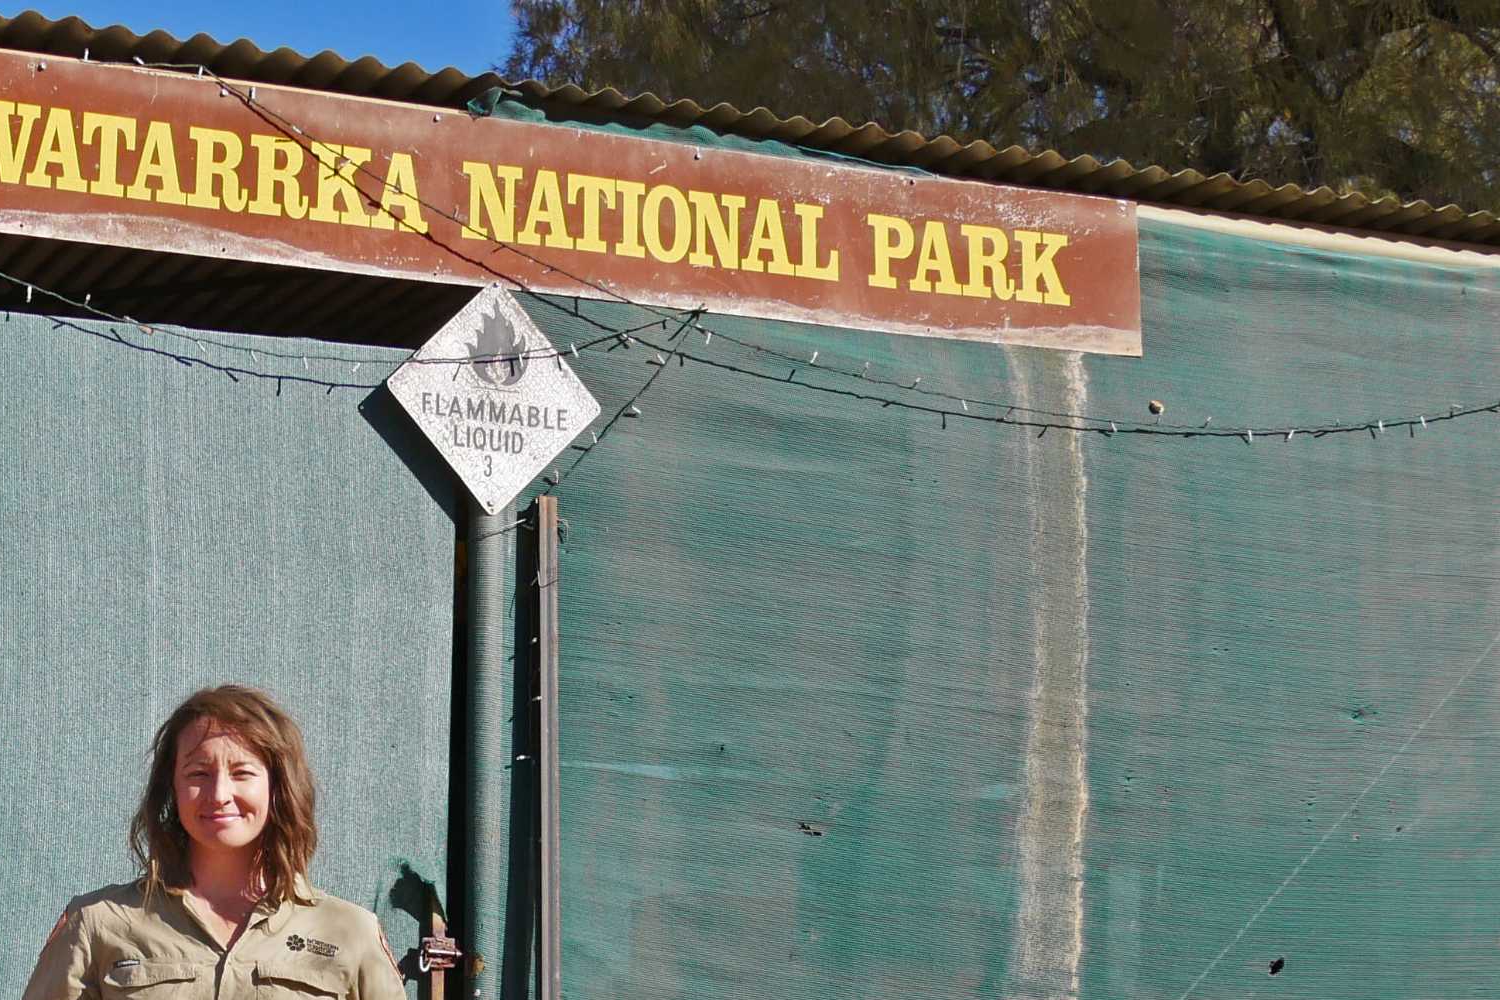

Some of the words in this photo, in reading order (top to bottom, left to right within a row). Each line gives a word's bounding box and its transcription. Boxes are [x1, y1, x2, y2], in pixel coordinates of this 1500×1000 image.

[461, 161, 840, 281] NATIONAL
[866, 213, 1071, 306] PARK
[421, 392, 568, 431] FLAMMABLE
[453, 425, 525, 455] LIQUID
[483, 455, 493, 478] 3
